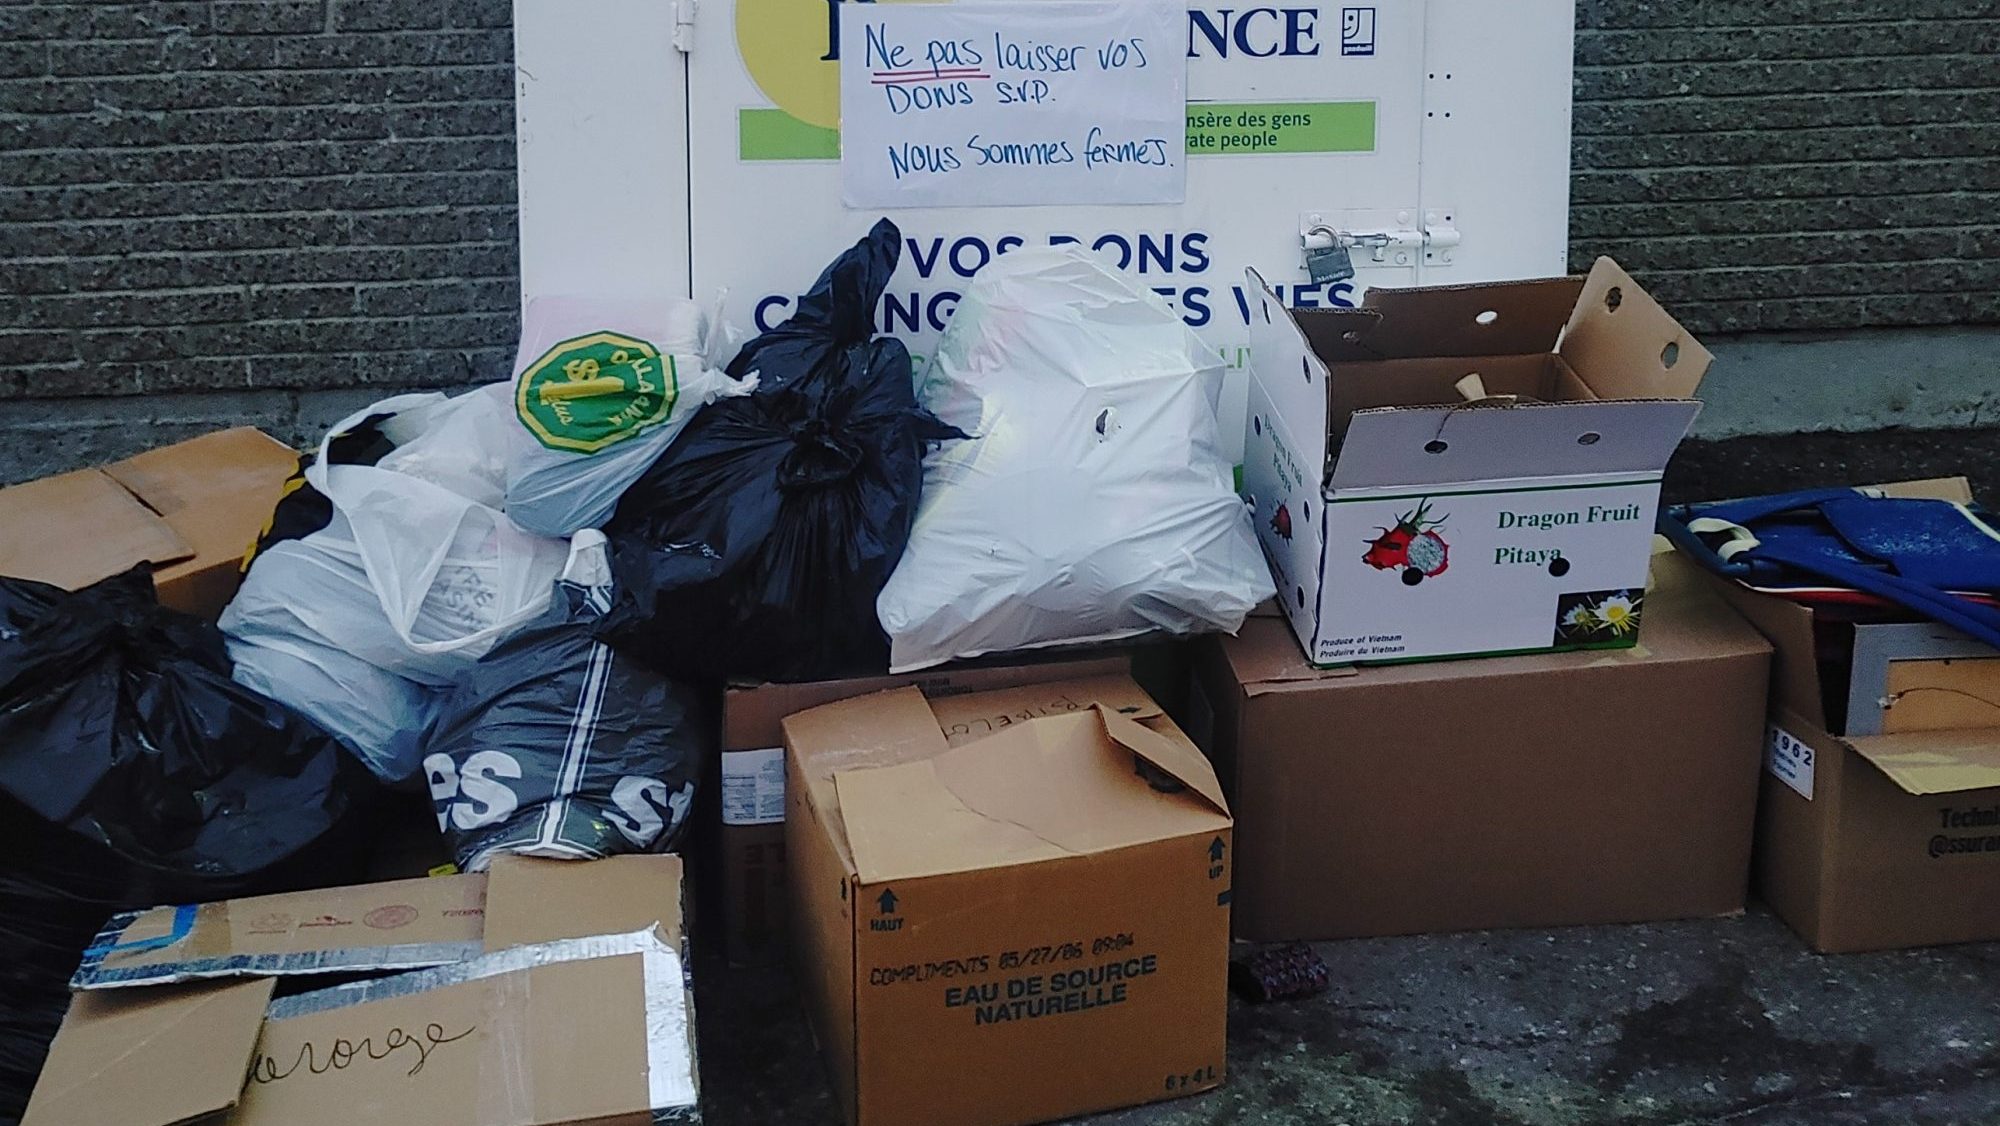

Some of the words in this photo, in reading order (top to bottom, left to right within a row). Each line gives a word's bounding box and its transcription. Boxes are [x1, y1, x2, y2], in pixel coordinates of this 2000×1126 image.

[1187, 8, 1320, 58] NCE
[865, 23, 913, 69] Ne
[927, 38, 983, 78] pas
[995, 32, 1087, 72] laisser
[885, 82, 974, 114] DONS
[1186, 112, 1232, 128] nsère
[1237, 112, 1266, 127] des
[1271, 113, 1311, 130] gens
[1221, 131, 1278, 151] people
[1049, 233, 1210, 274] ONS
[1497, 511, 1580, 531] Dragon
[1586, 503, 1641, 523] Fruit
[1495, 547, 1562, 566] Pitaya
[1320, 637, 1354, 647] Produce
[1357, 636, 1366, 644] of
[1368, 635, 1402, 644] Vietnam
[1357, 647, 1369, 655] du
[1372, 646, 1405, 654] Vietnam
[1208, 864, 1224, 879] UP
[869, 917, 904, 931] HAUT
[869, 955, 990, 986] COMPLIMENTS
[944, 982, 998, 1008] EAU
[1007, 975, 1042, 999] DE
[1050, 954, 1158, 991] SOURCE
[974, 983, 1128, 1026] NATURELLE
